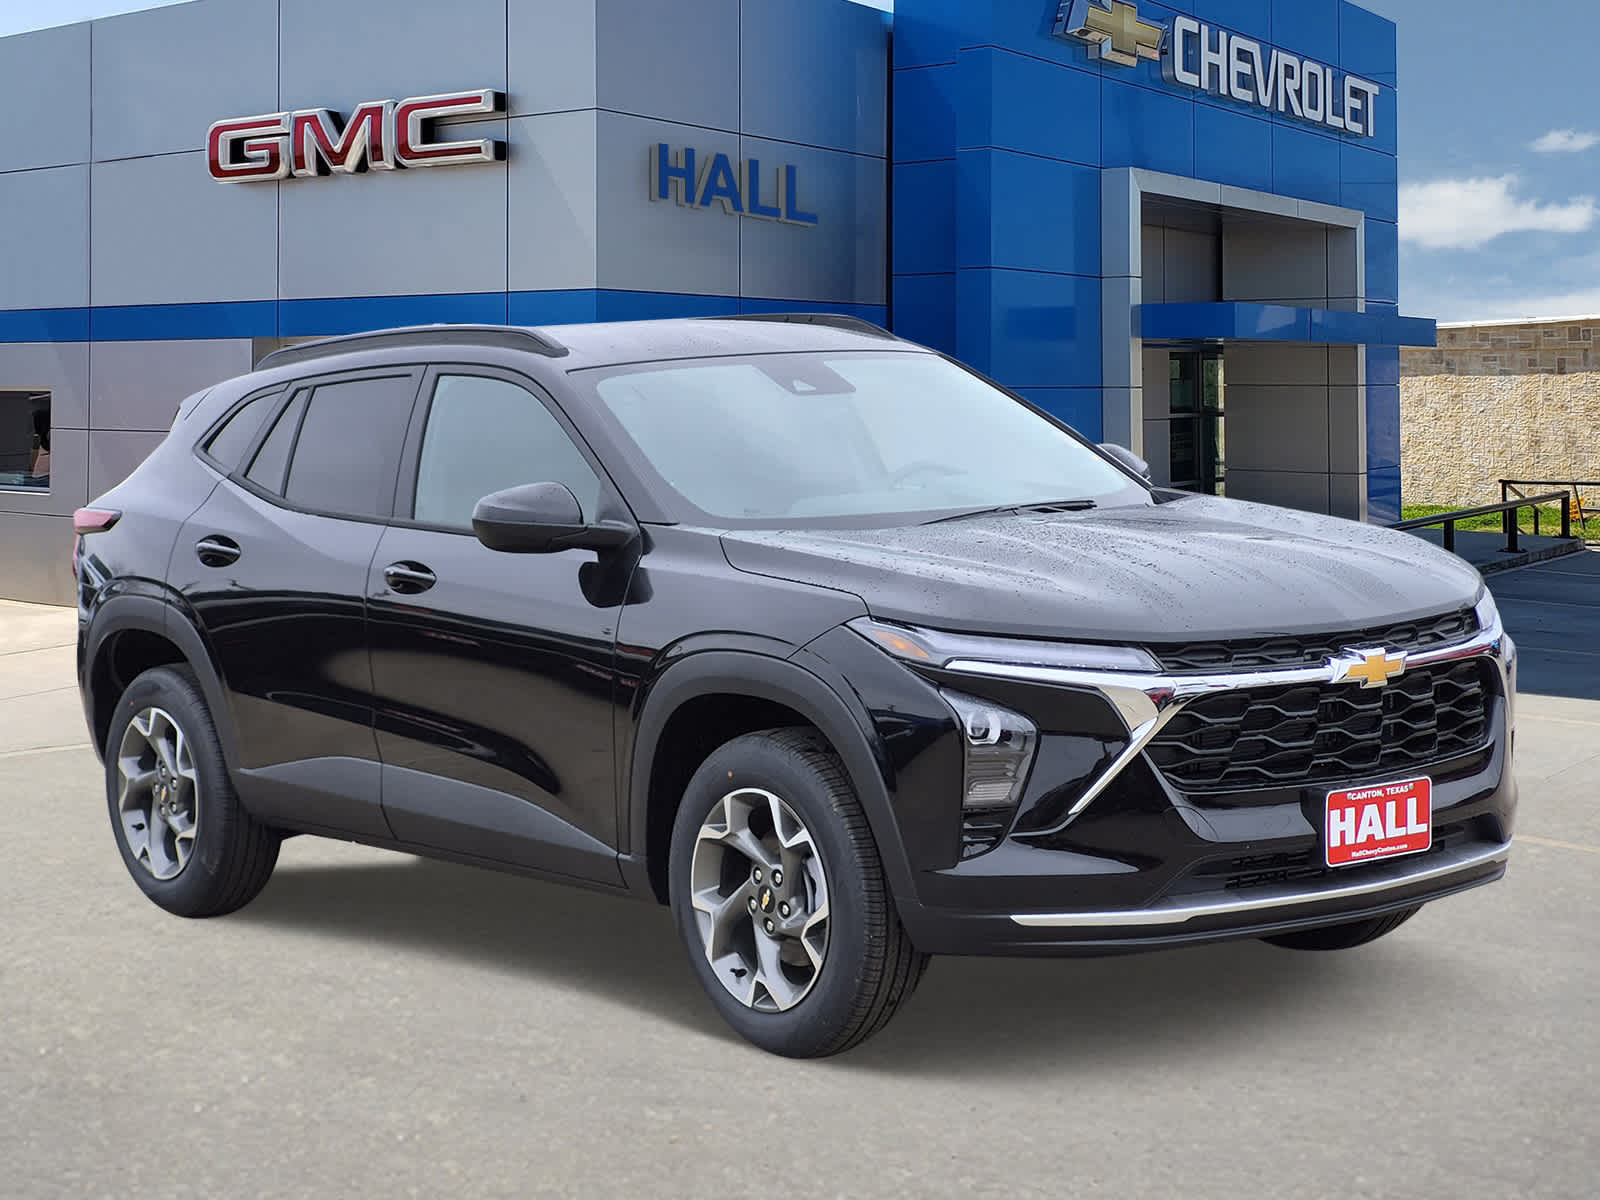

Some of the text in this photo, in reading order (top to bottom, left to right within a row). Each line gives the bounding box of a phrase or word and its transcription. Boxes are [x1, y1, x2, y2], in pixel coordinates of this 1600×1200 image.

[1174, 15, 1380, 137] CHEVROLET
[207, 88, 505, 184] GMC
[656, 143, 818, 225] HALL
[1329, 797, 1428, 847] HALL
[1351, 784, 1409, 800] CANTON, TEXAS
